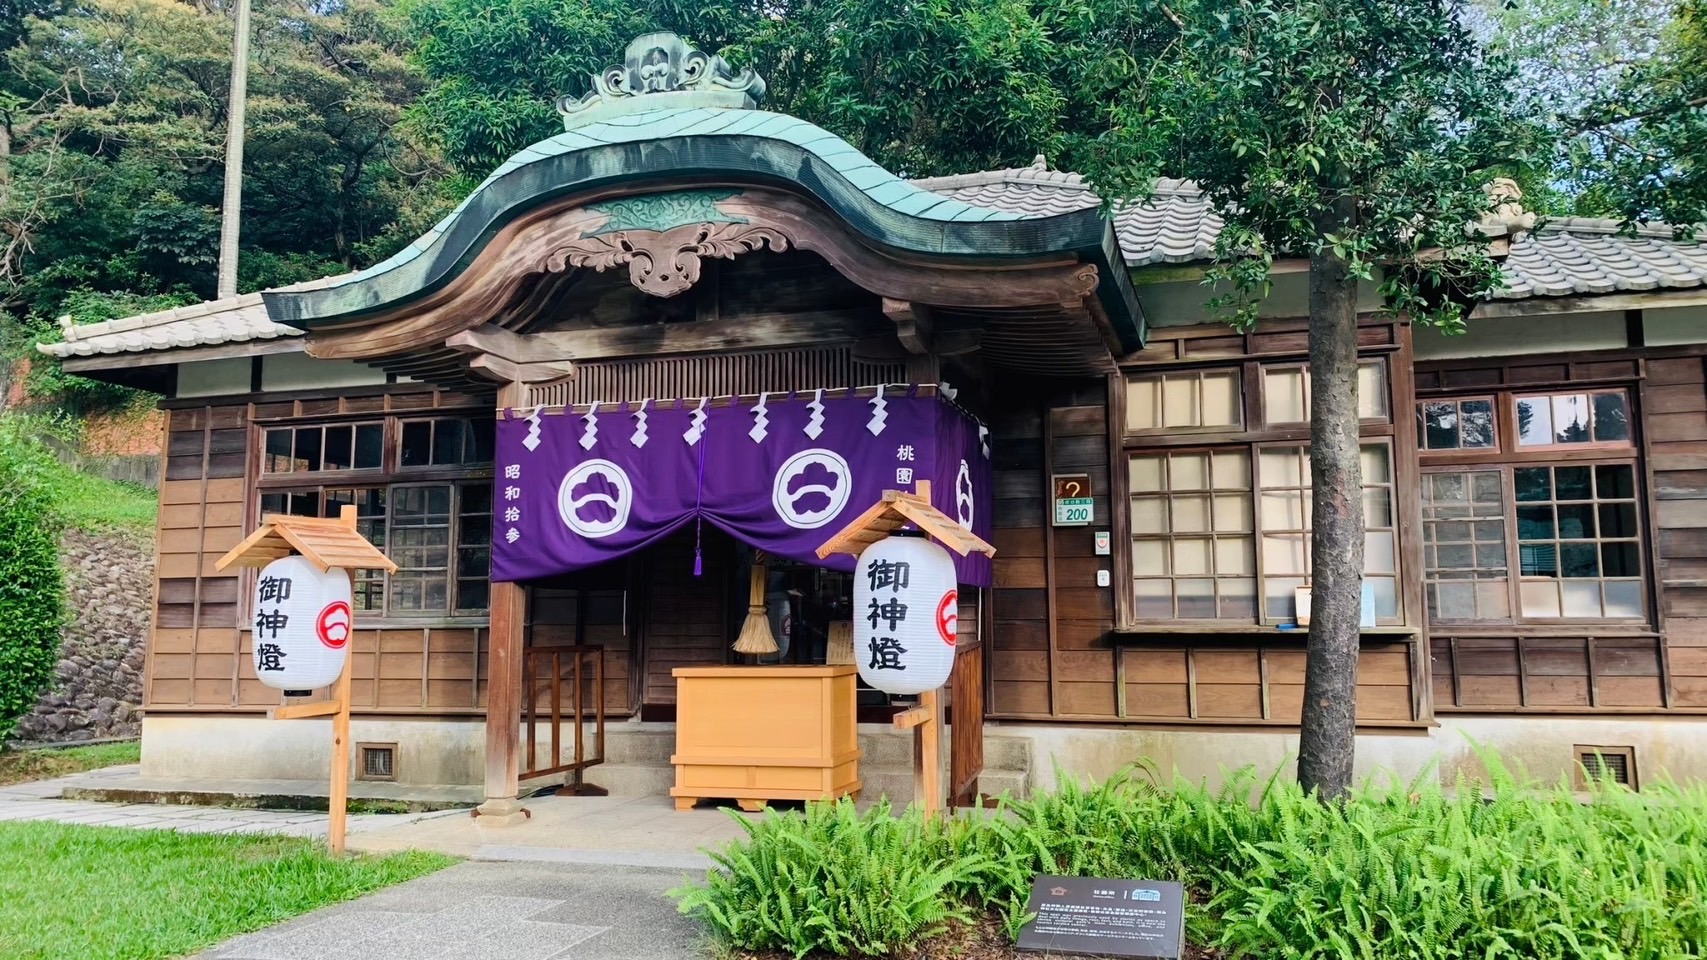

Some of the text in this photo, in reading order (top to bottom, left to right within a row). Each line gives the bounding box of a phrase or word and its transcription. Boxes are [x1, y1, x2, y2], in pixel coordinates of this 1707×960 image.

[504, 464, 520, 544] 昭和拾参
[1066, 508, 1088, 520] 200
[256, 576, 292, 671] 御神燈
[867, 559, 910, 670] 御神燈
